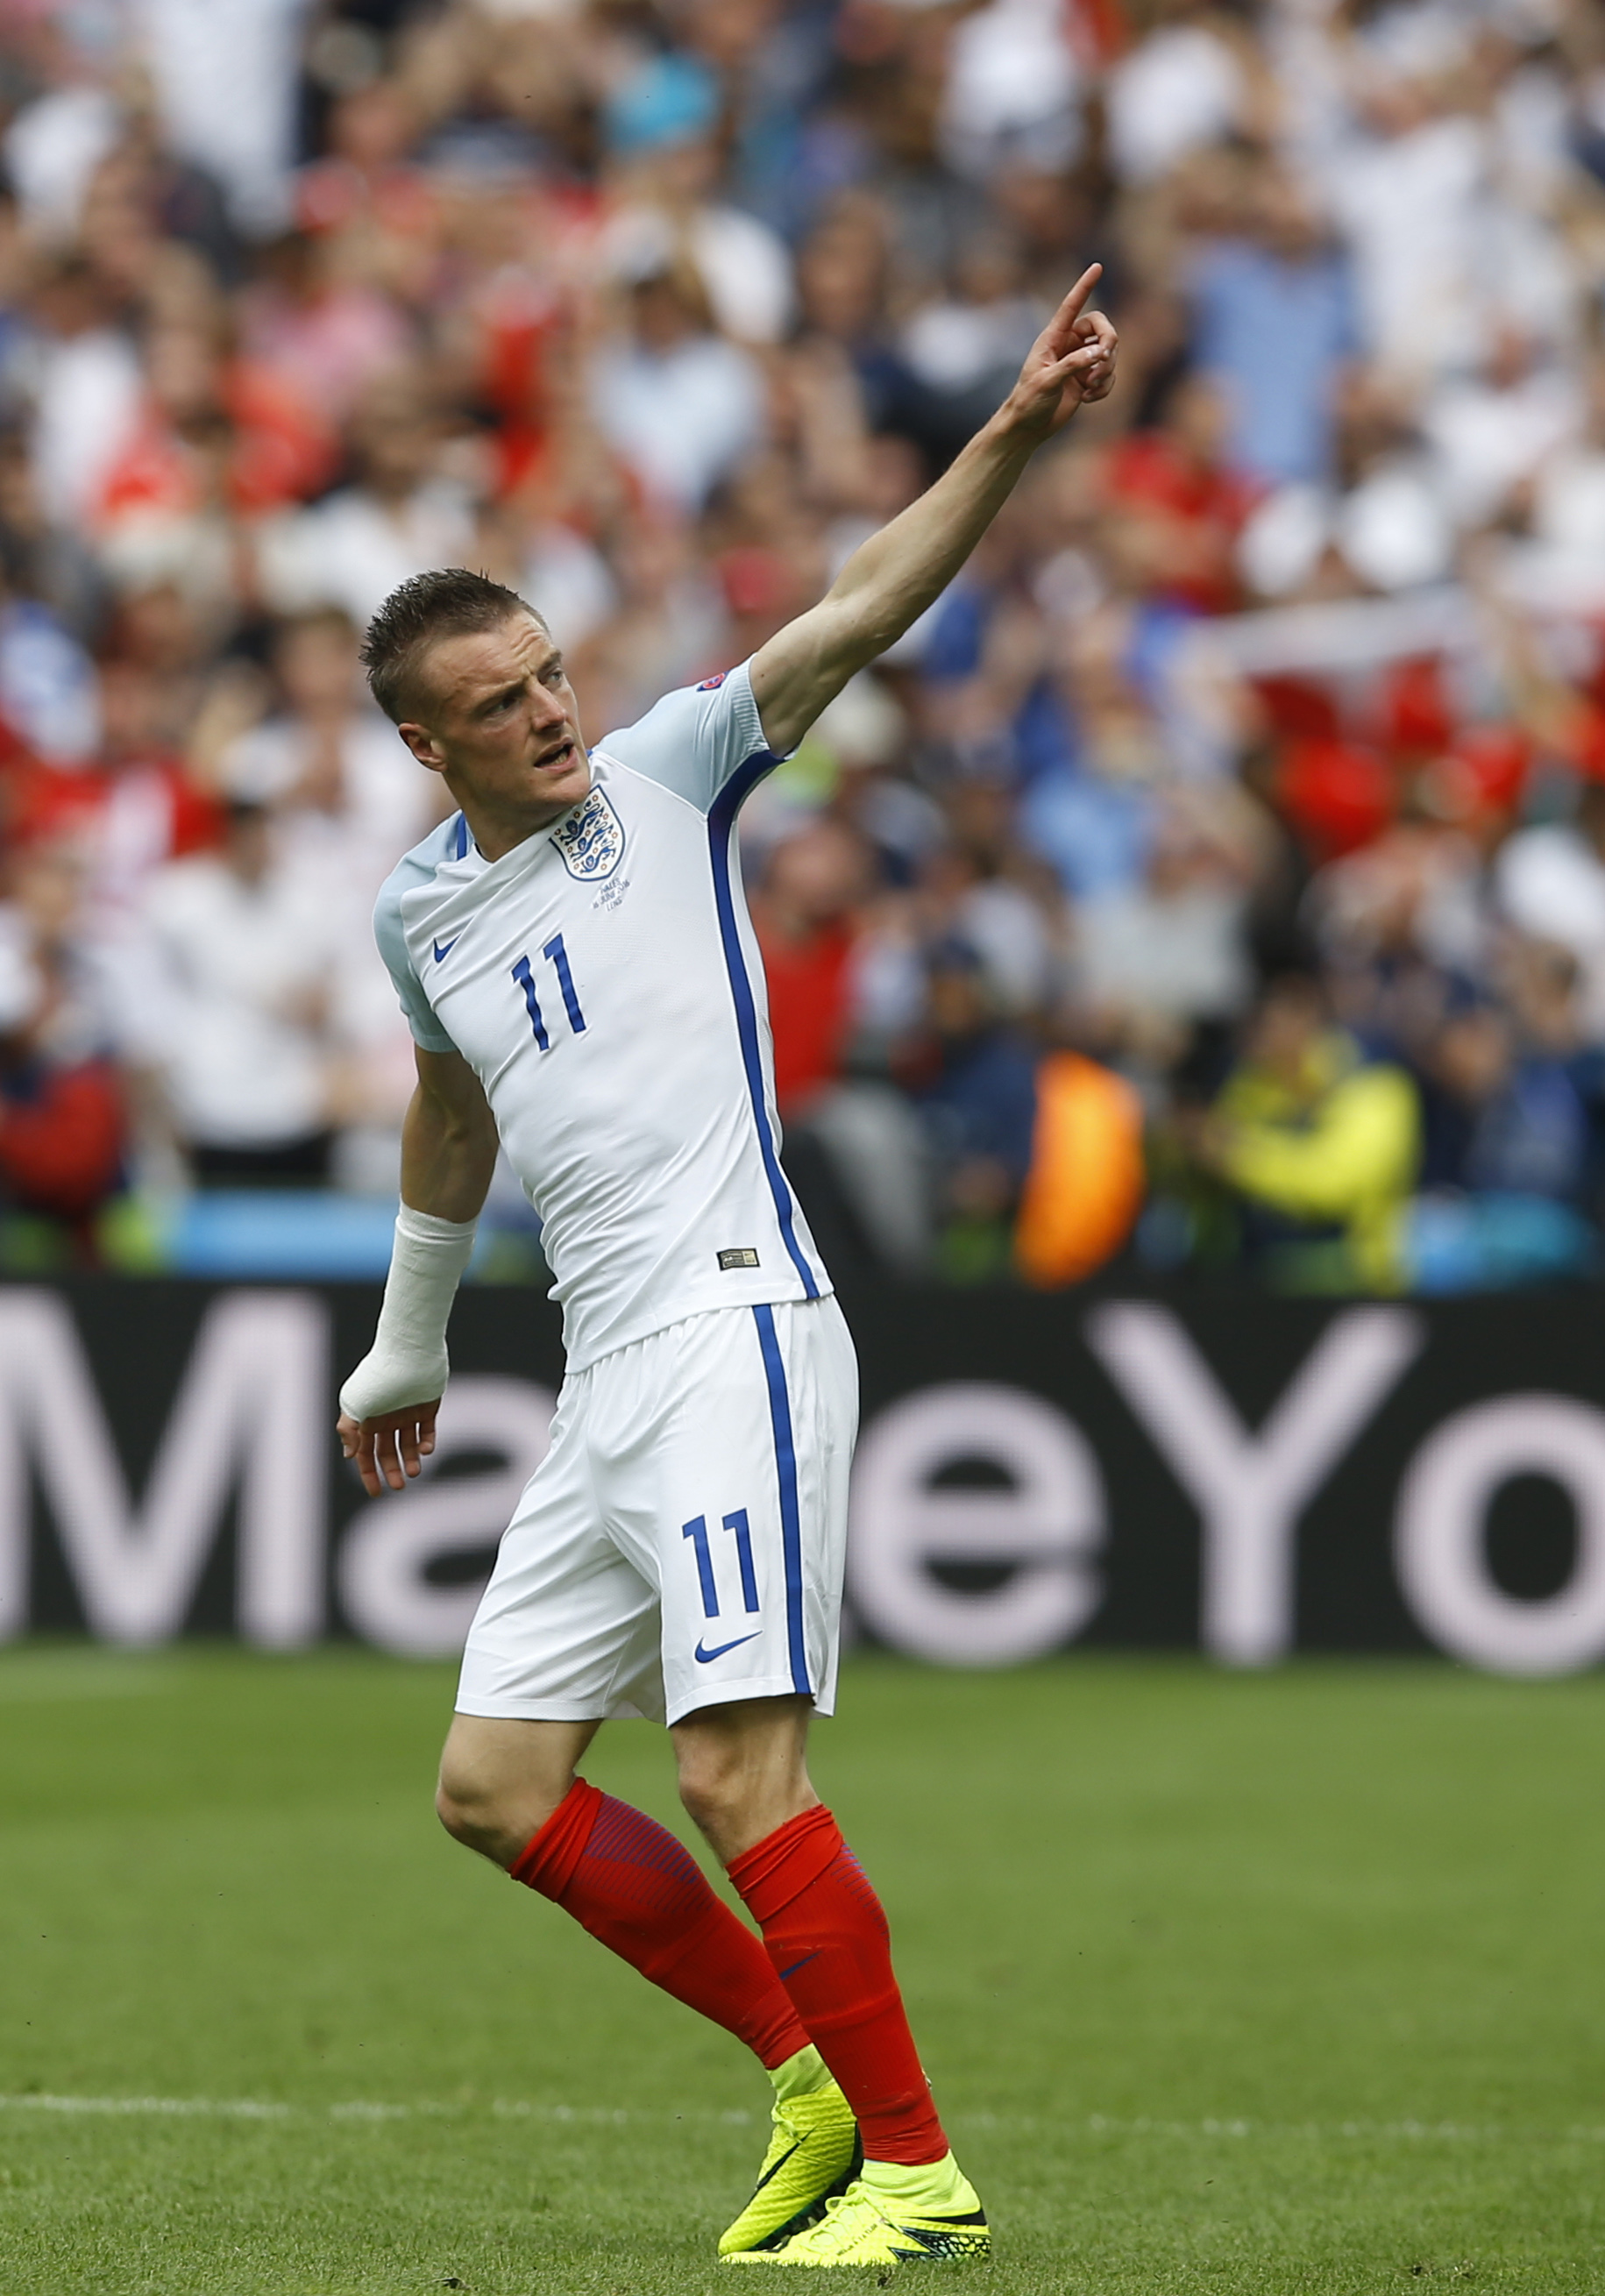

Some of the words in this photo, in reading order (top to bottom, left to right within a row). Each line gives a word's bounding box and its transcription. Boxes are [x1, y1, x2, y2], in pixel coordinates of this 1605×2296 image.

[607, 895, 623, 912] LENS
[511, 932, 586, 1052] 11
[682, 1507, 760, 1618] 11
